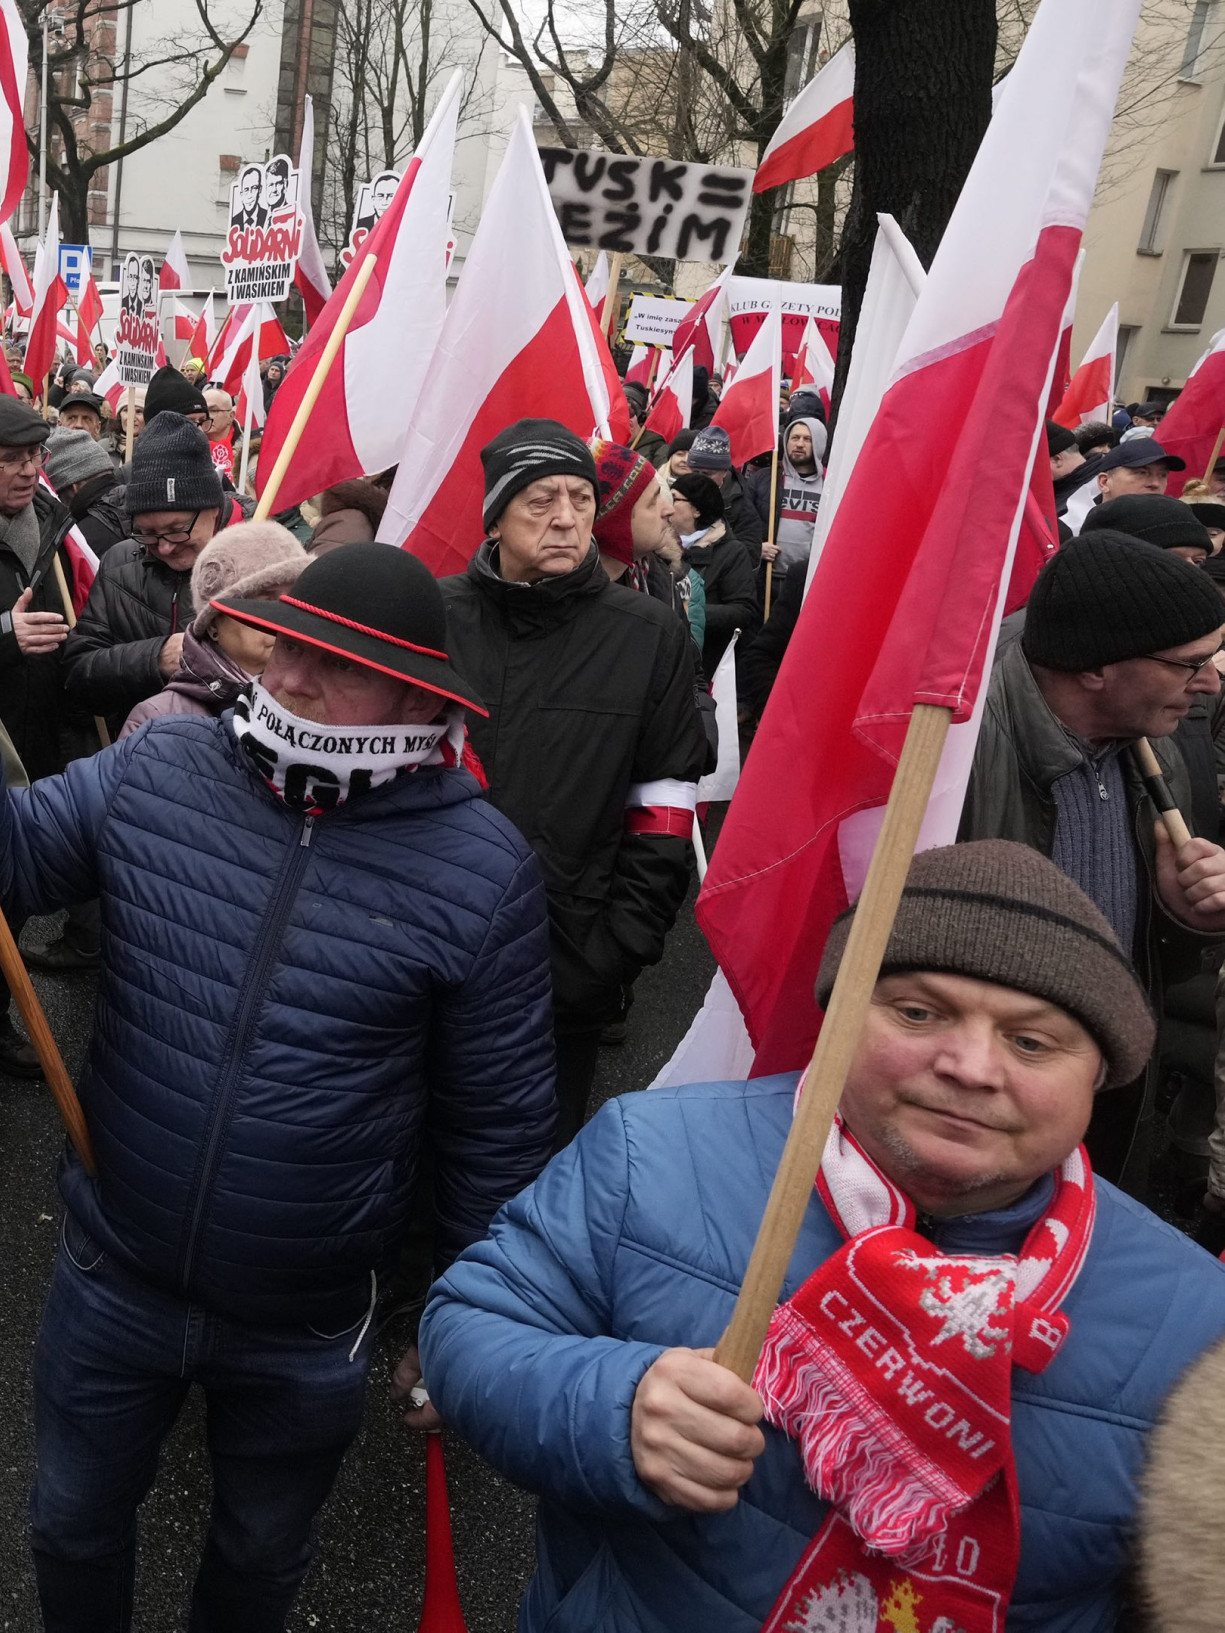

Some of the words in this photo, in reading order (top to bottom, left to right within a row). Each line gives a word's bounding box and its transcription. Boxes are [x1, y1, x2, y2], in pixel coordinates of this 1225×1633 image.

[539, 149, 687, 203] TUSK
[228, 270, 233, 284] Z
[235, 263, 291, 284] KAMIŃSKIM
[236, 281, 285, 302] WĄSIKIEM
[761, 301, 814, 312] GZETY
[257, 704, 396, 754] POŁĄCZONYCH
[820, 1290, 996, 1459] CZERWONI
